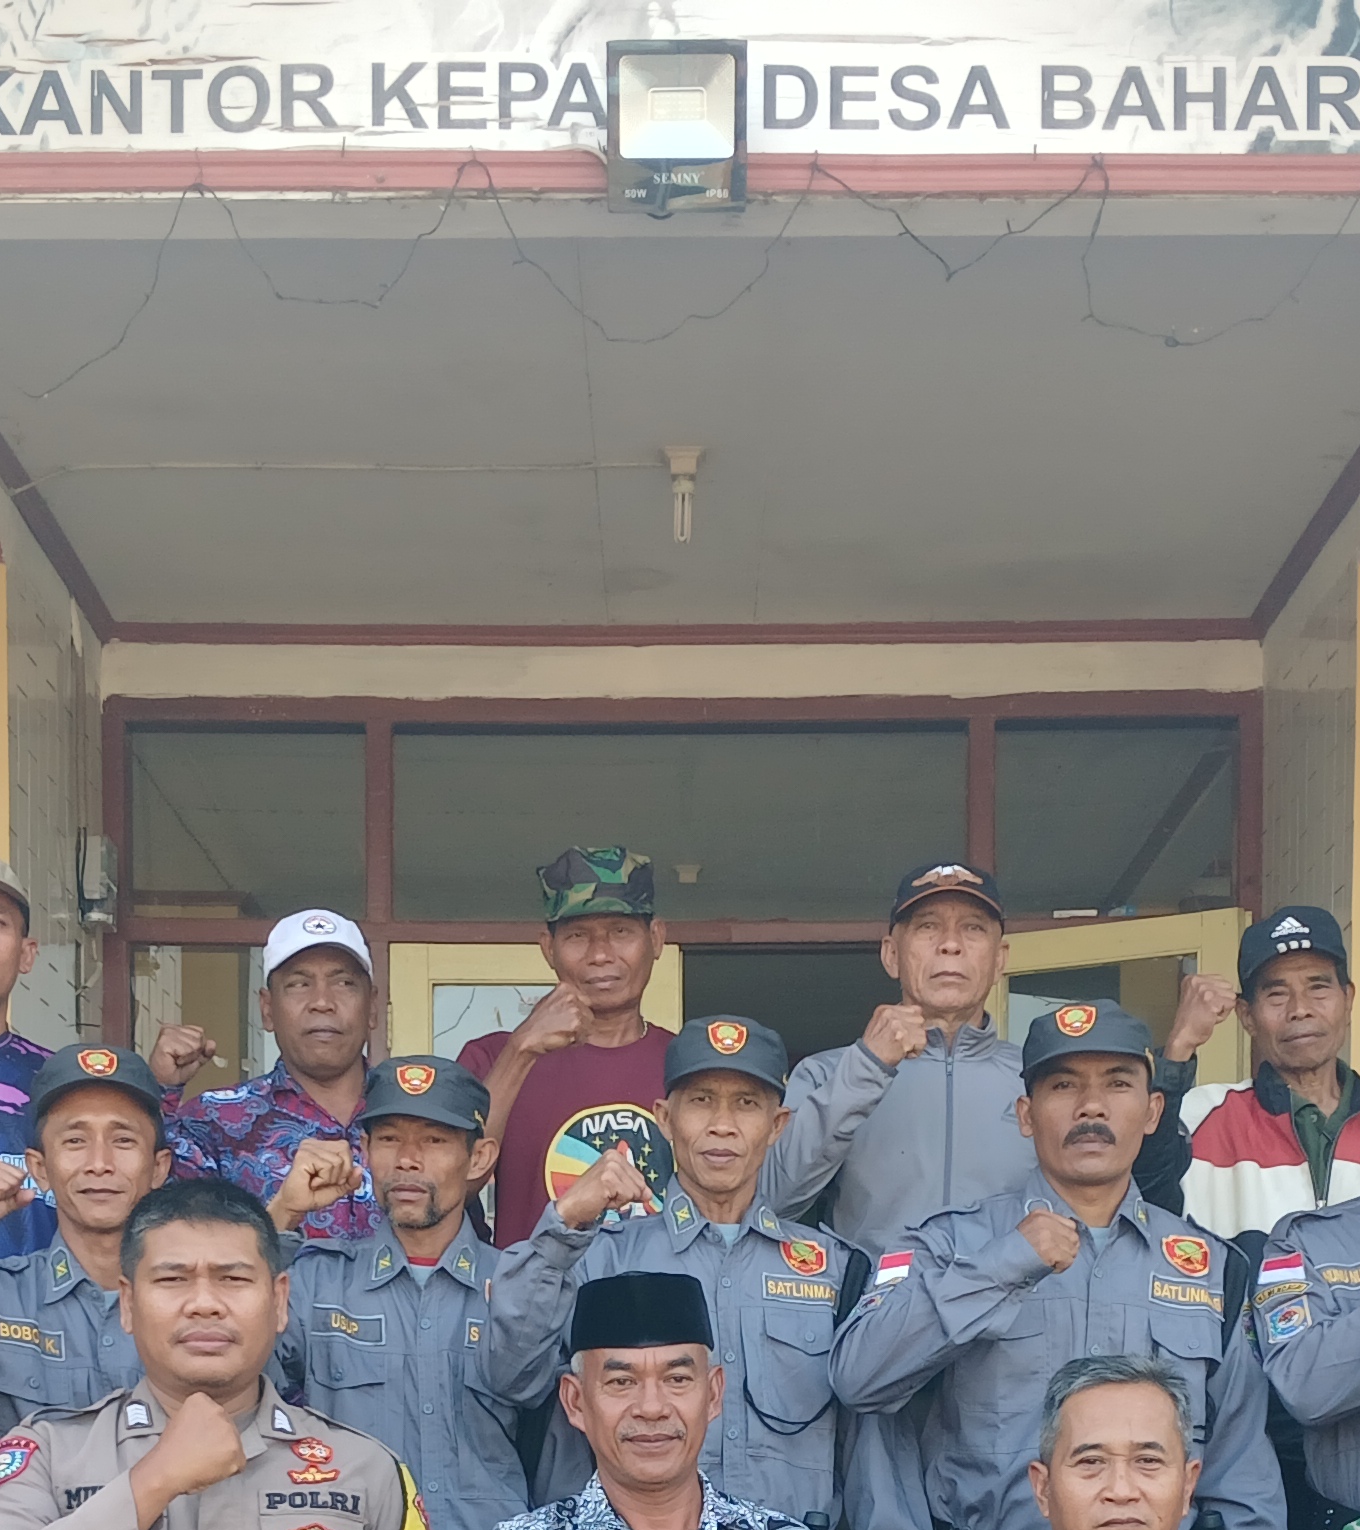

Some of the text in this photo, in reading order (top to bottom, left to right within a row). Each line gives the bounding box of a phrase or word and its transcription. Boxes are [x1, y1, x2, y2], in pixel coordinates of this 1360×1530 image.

[371, 61, 607, 129] KEPA
[762, 63, 1009, 131] DESA
[653, 172, 701, 184] SEMNY
[582, 1111, 651, 1141] NASA
[265, 1491, 361, 1515] POLRI
